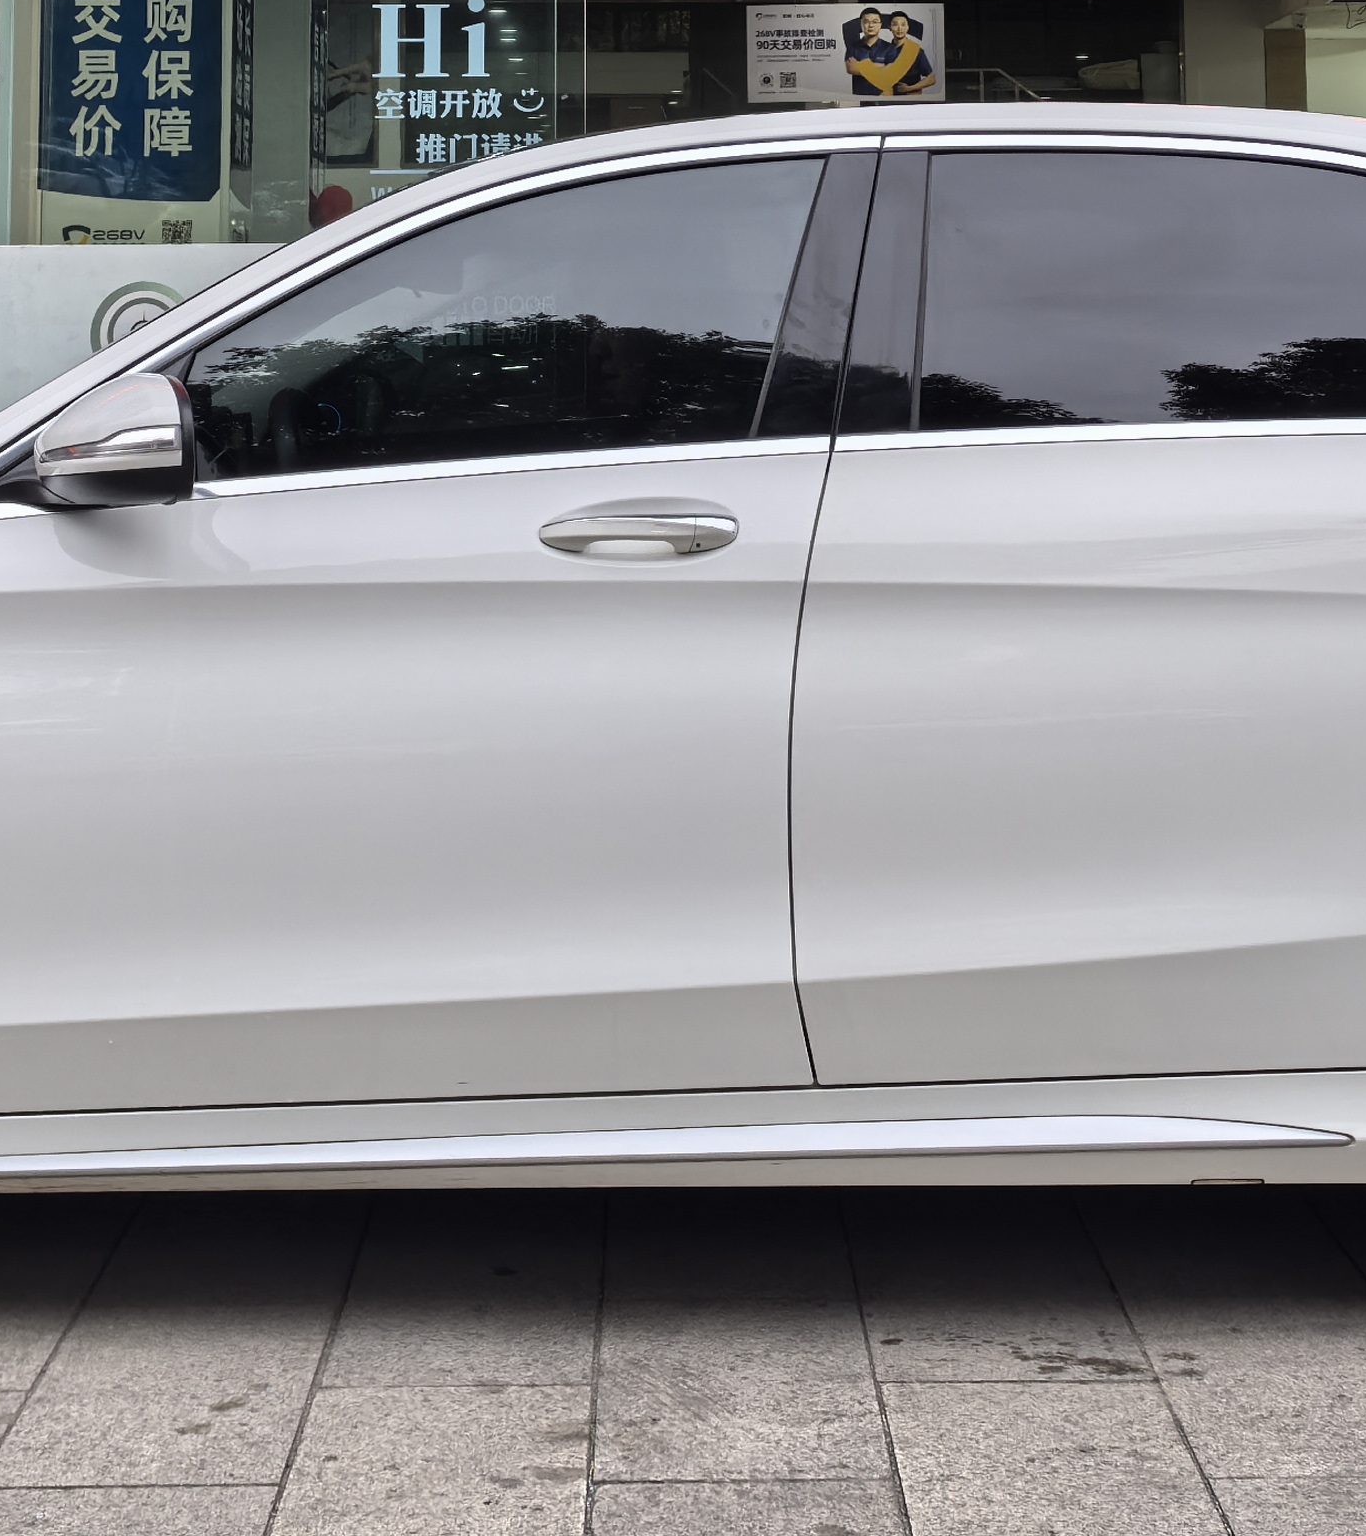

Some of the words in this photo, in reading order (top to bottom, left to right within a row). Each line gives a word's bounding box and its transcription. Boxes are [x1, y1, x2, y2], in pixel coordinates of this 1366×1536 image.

[756, 39, 837, 52] 90天交易价回购
[374, 87, 503, 119] 空调开放
